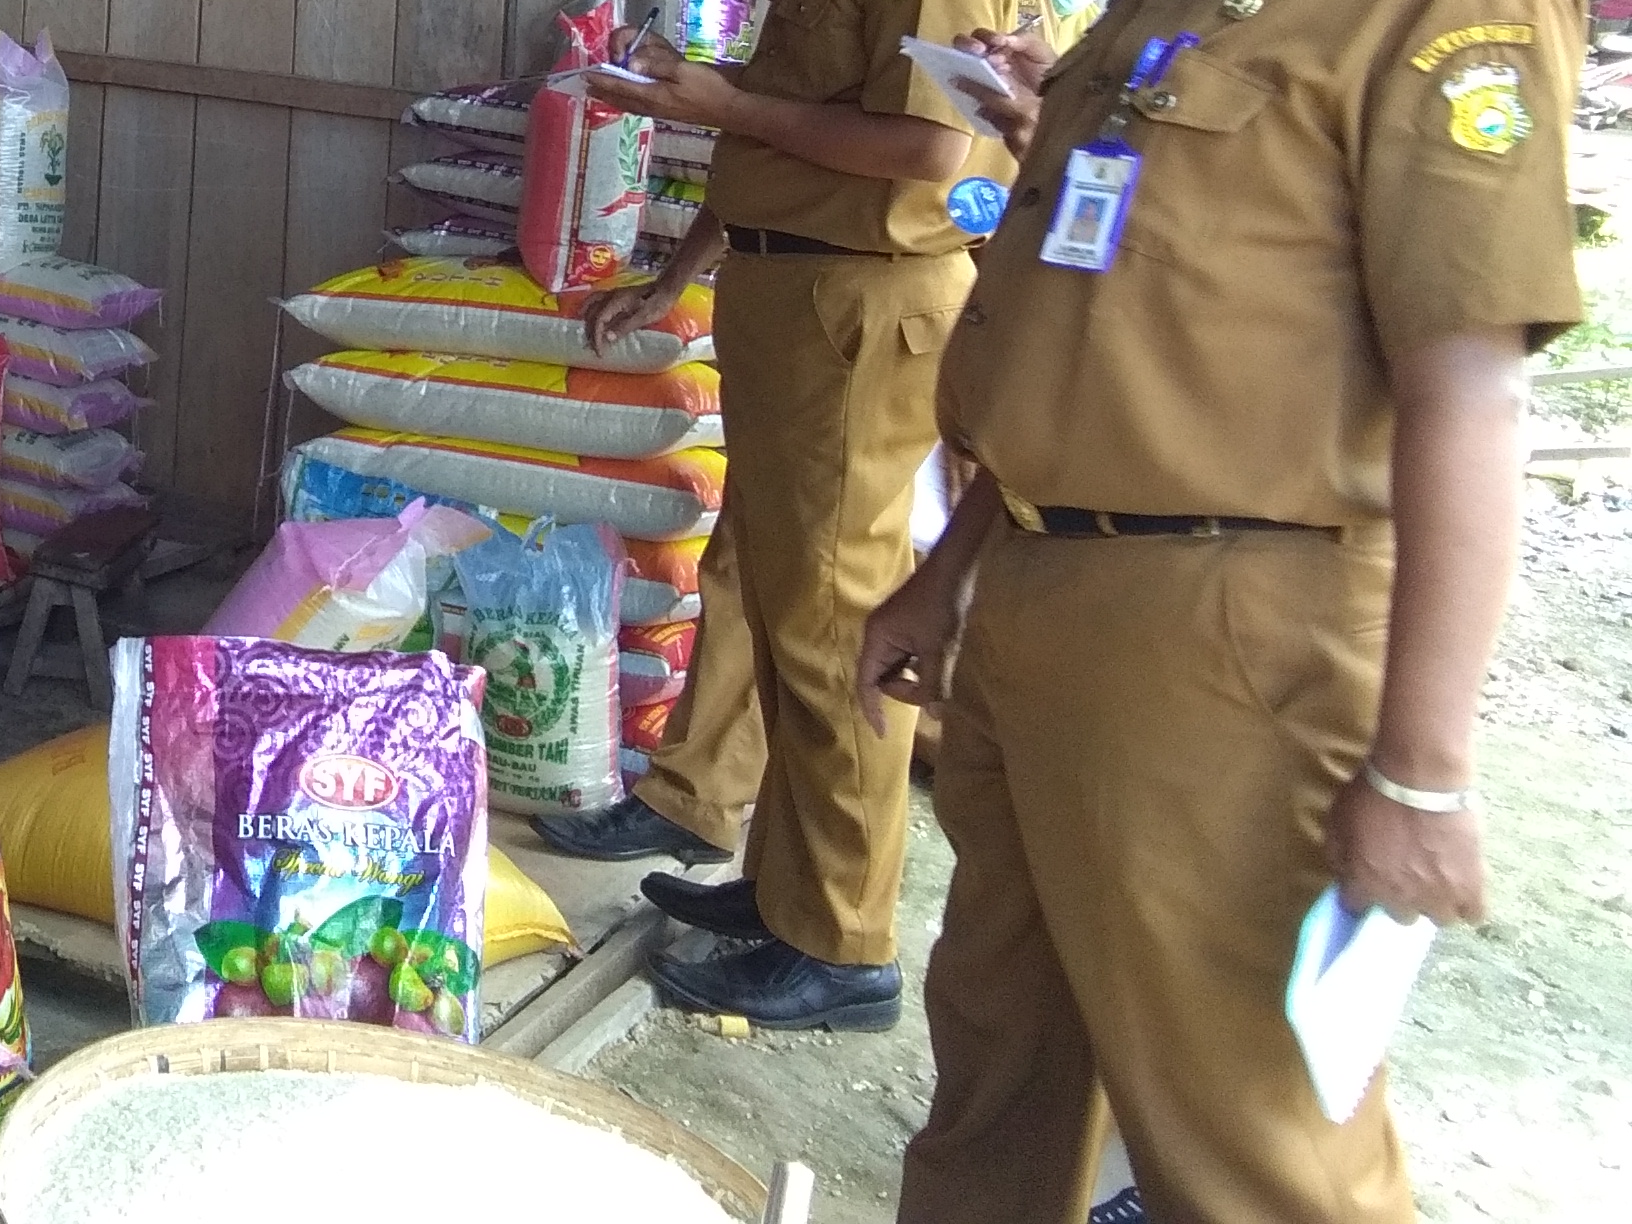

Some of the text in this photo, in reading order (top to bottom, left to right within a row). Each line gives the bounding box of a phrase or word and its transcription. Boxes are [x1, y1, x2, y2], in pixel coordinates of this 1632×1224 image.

[144, 644, 153, 674] SYF
[144, 681, 155, 708] SYF
[141, 715, 151, 745] SYF
[143, 753, 153, 783] SYF
[489, 755, 537, 774] AU-BAU
[311, 763, 387, 803] SYF
[140, 787, 152, 818] SYF
[137, 825, 148, 856] SYF
[237, 813, 457, 858] BERAS KEPALA
[132, 862, 145, 892] SYF
[132, 899, 142, 930] SYF
